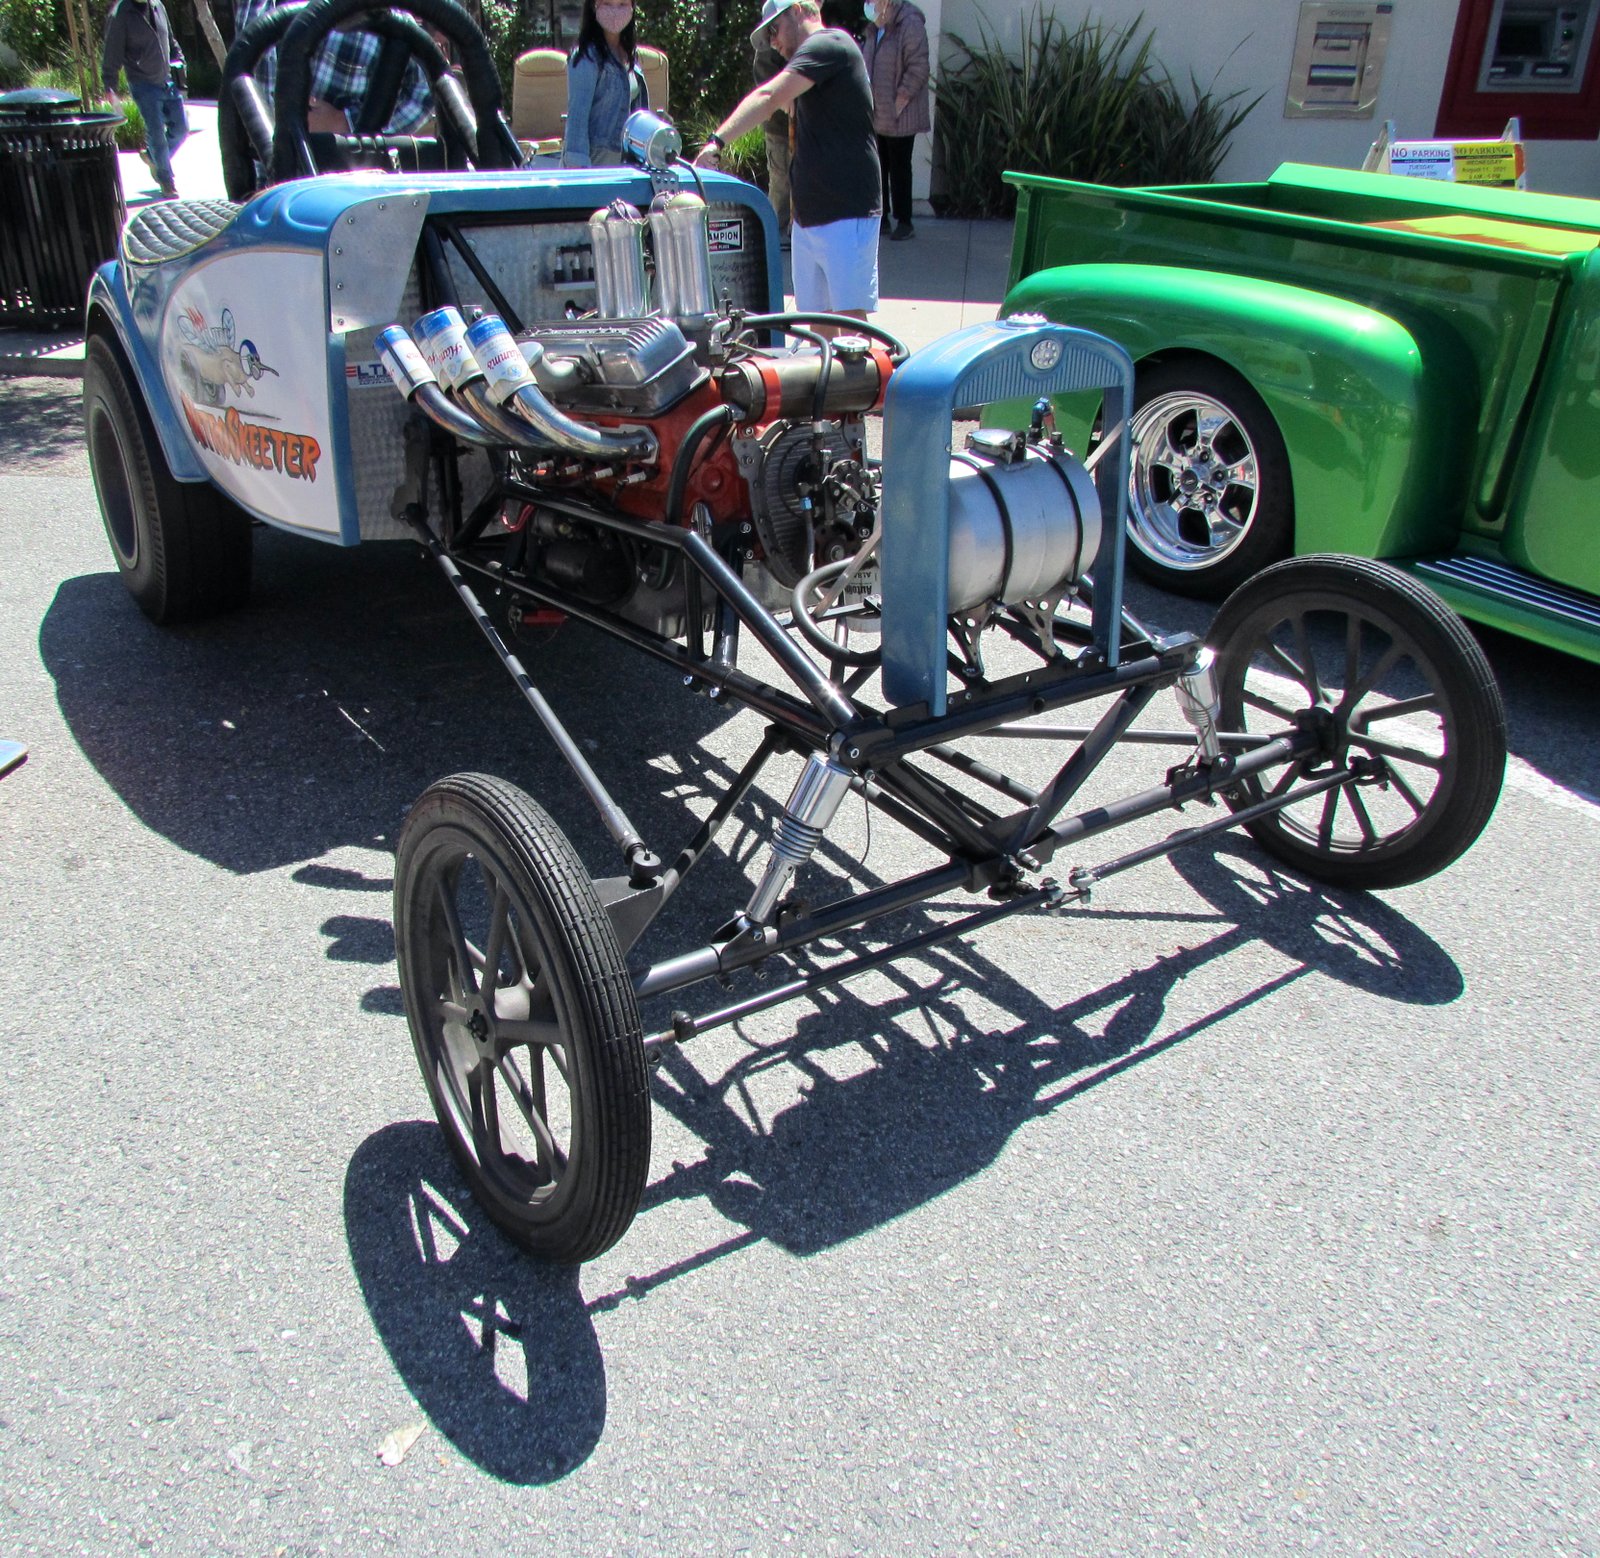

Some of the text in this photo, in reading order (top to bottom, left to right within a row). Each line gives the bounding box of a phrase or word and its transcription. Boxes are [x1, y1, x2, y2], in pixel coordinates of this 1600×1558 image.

[1391, 148, 1450, 158] NO PARKING
[1454, 146, 1508, 155] NO PARKING
[709, 231, 738, 241] AMPION
